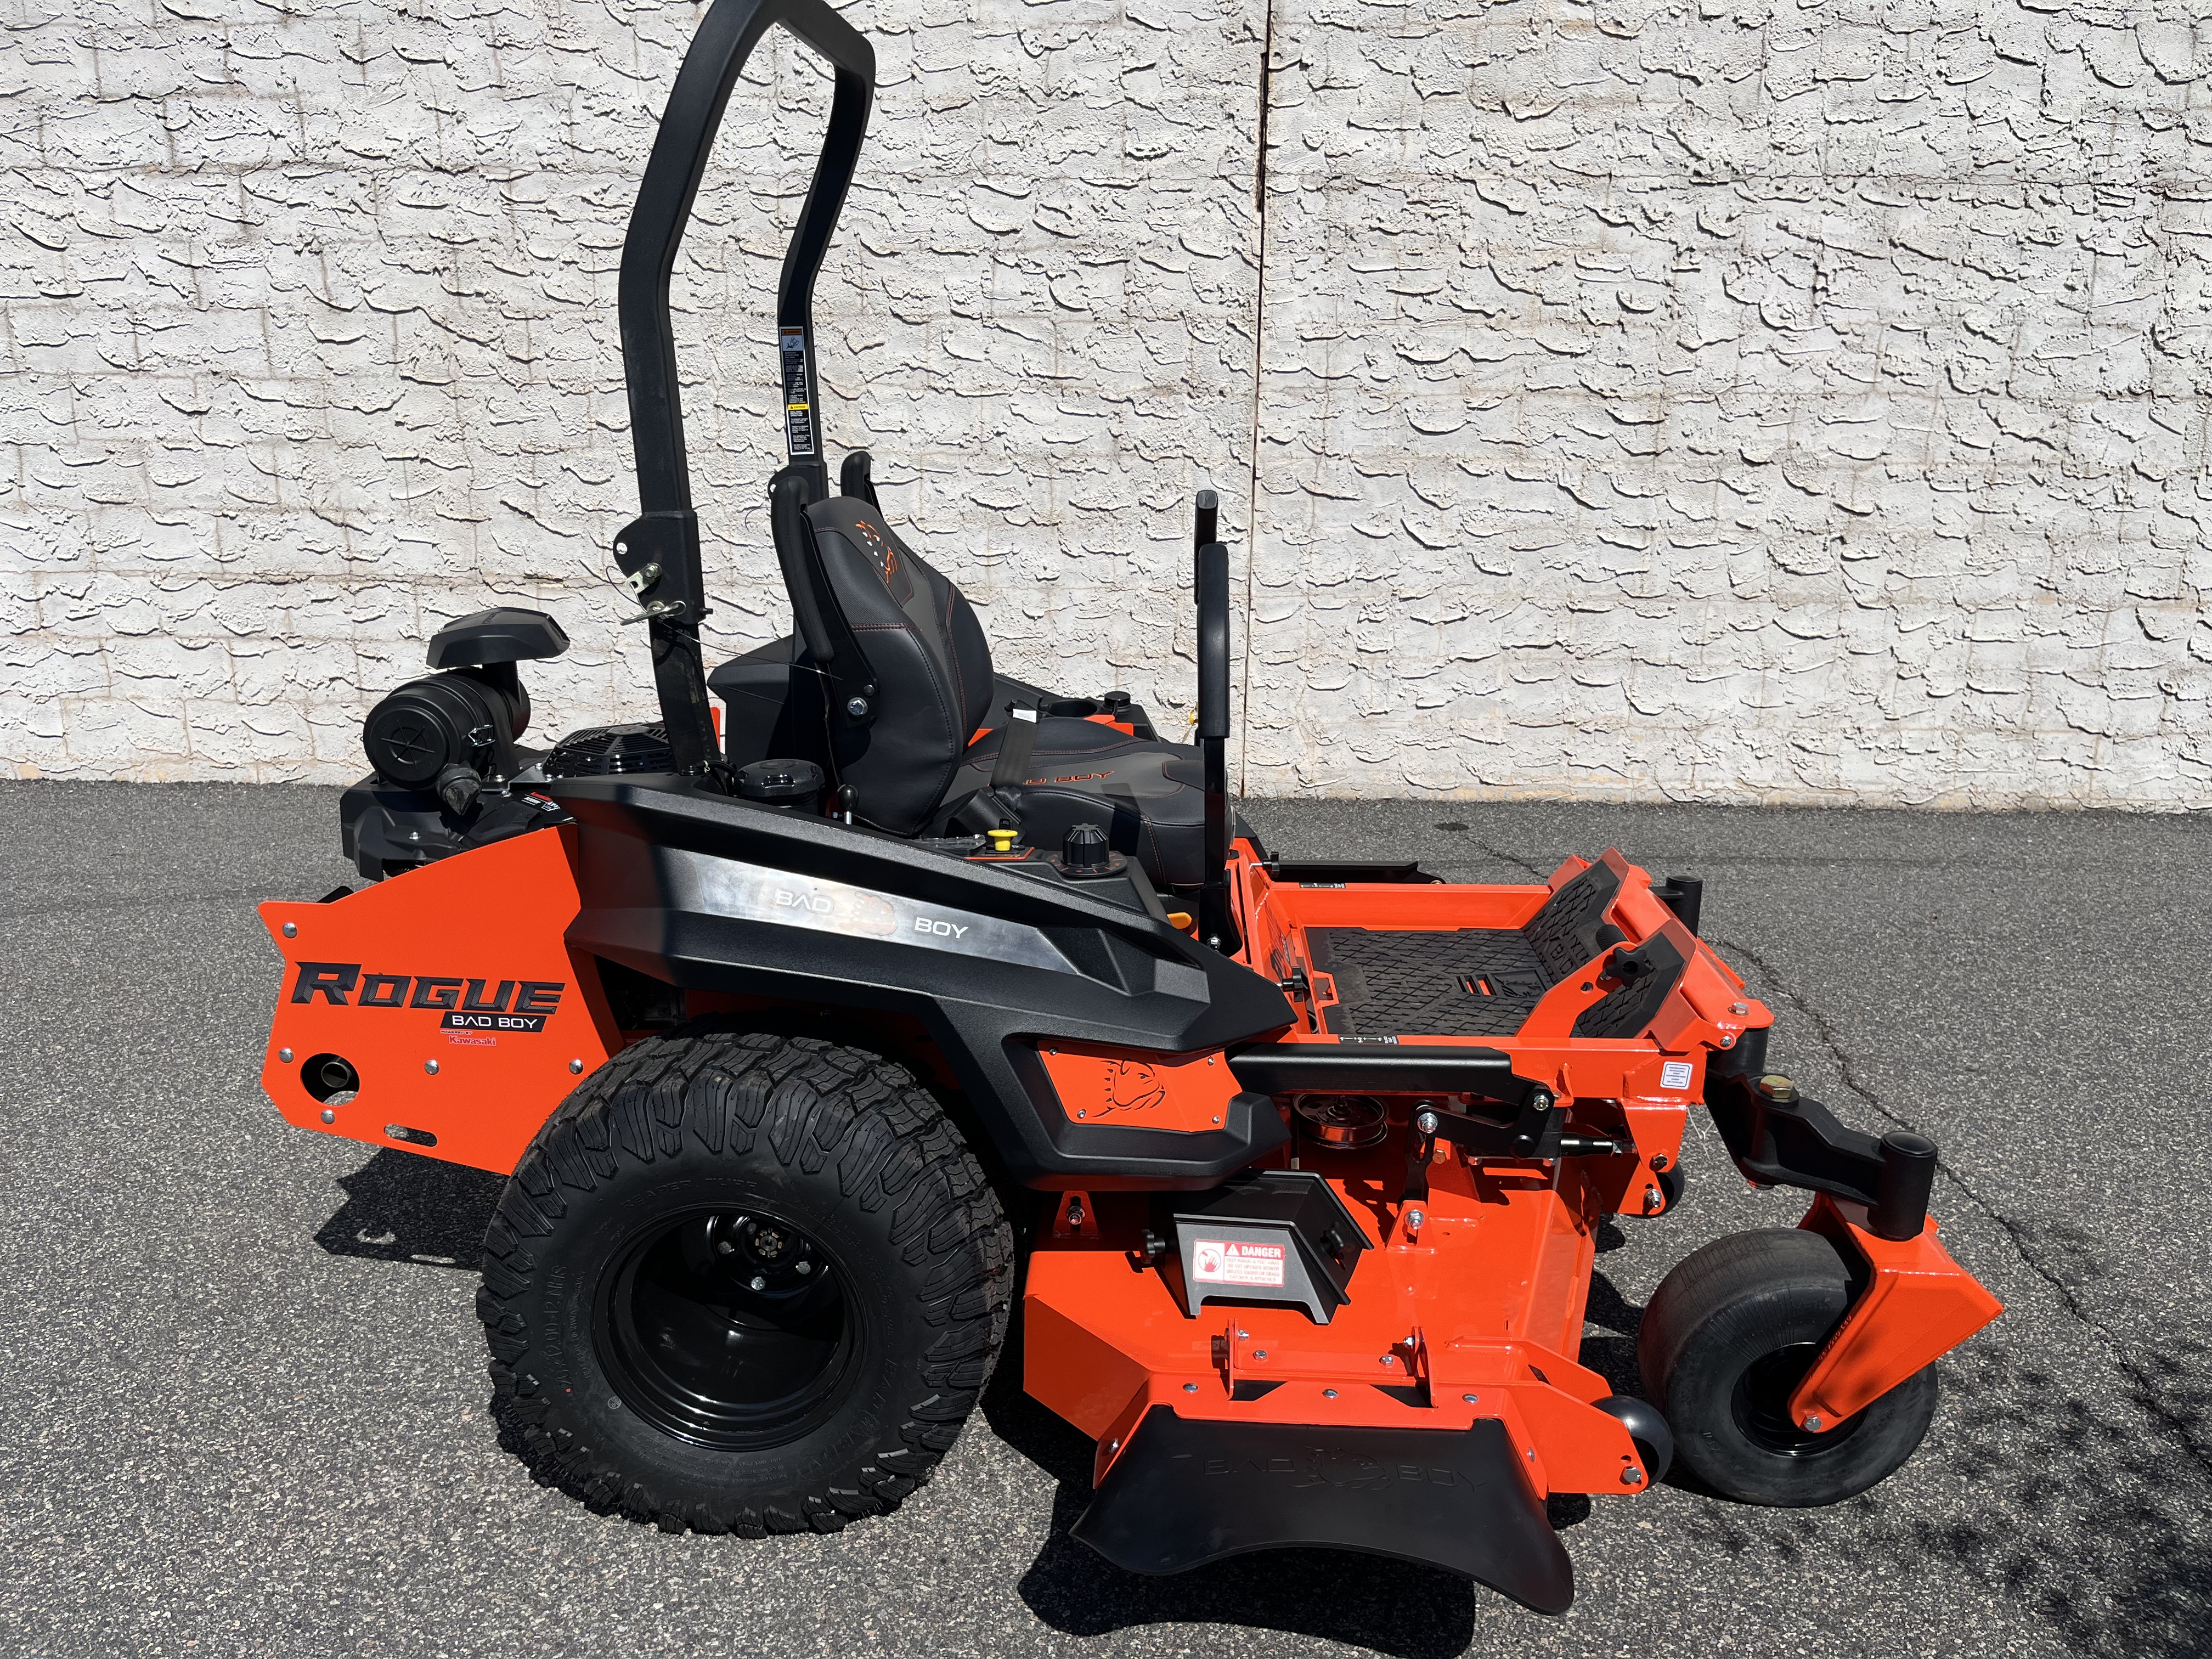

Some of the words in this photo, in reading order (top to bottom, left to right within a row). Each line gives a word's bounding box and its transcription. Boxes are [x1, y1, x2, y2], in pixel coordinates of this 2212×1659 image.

[1054, 770, 1115, 783] BOY
[775, 890, 832, 913] BAD
[914, 917, 969, 939] BOY
[290, 961, 566, 1014] ROGUE
[452, 1015, 492, 1026] BAD
[498, 1018, 539, 1029] BOY
[449, 1036, 496, 1046] Kawasaki
[1241, 1245, 1282, 1258] DANGER
[1204, 1458, 1296, 1476] BAD
[1396, 1463, 1488, 1493] BOY
